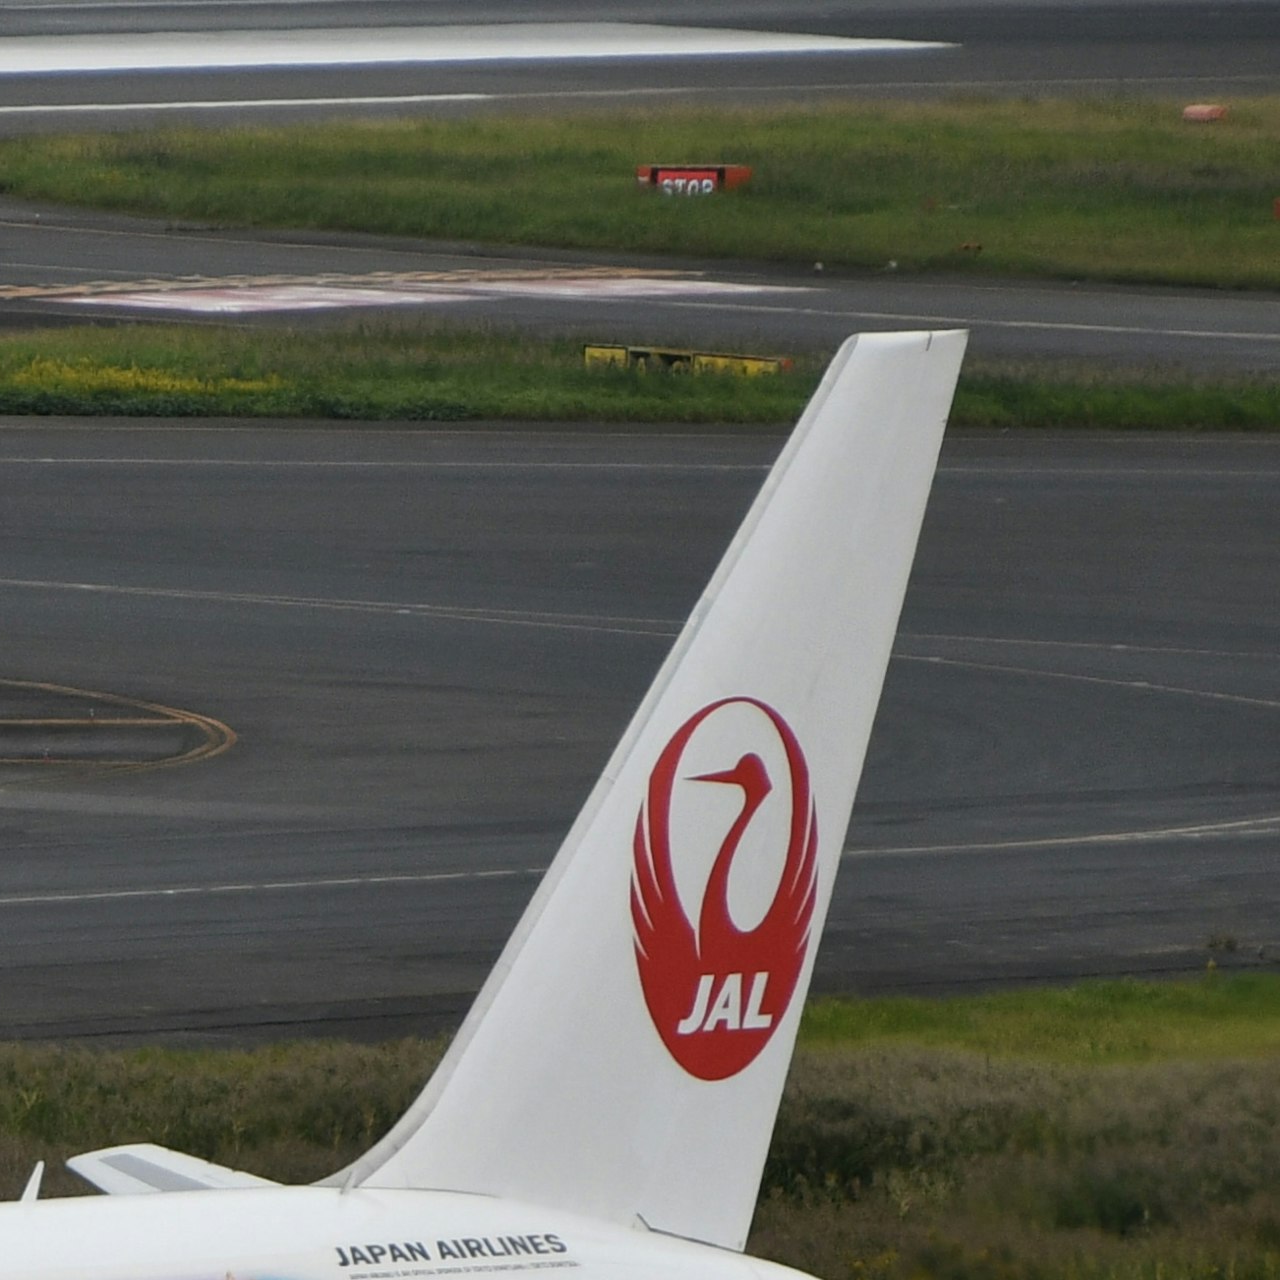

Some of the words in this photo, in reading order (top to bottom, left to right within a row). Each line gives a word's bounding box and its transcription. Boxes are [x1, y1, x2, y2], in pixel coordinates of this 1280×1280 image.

[676, 971, 773, 1034] JAL
[335, 1241, 431, 1267] JAPAN
[438, 1233, 568, 1260] AIRLINES
